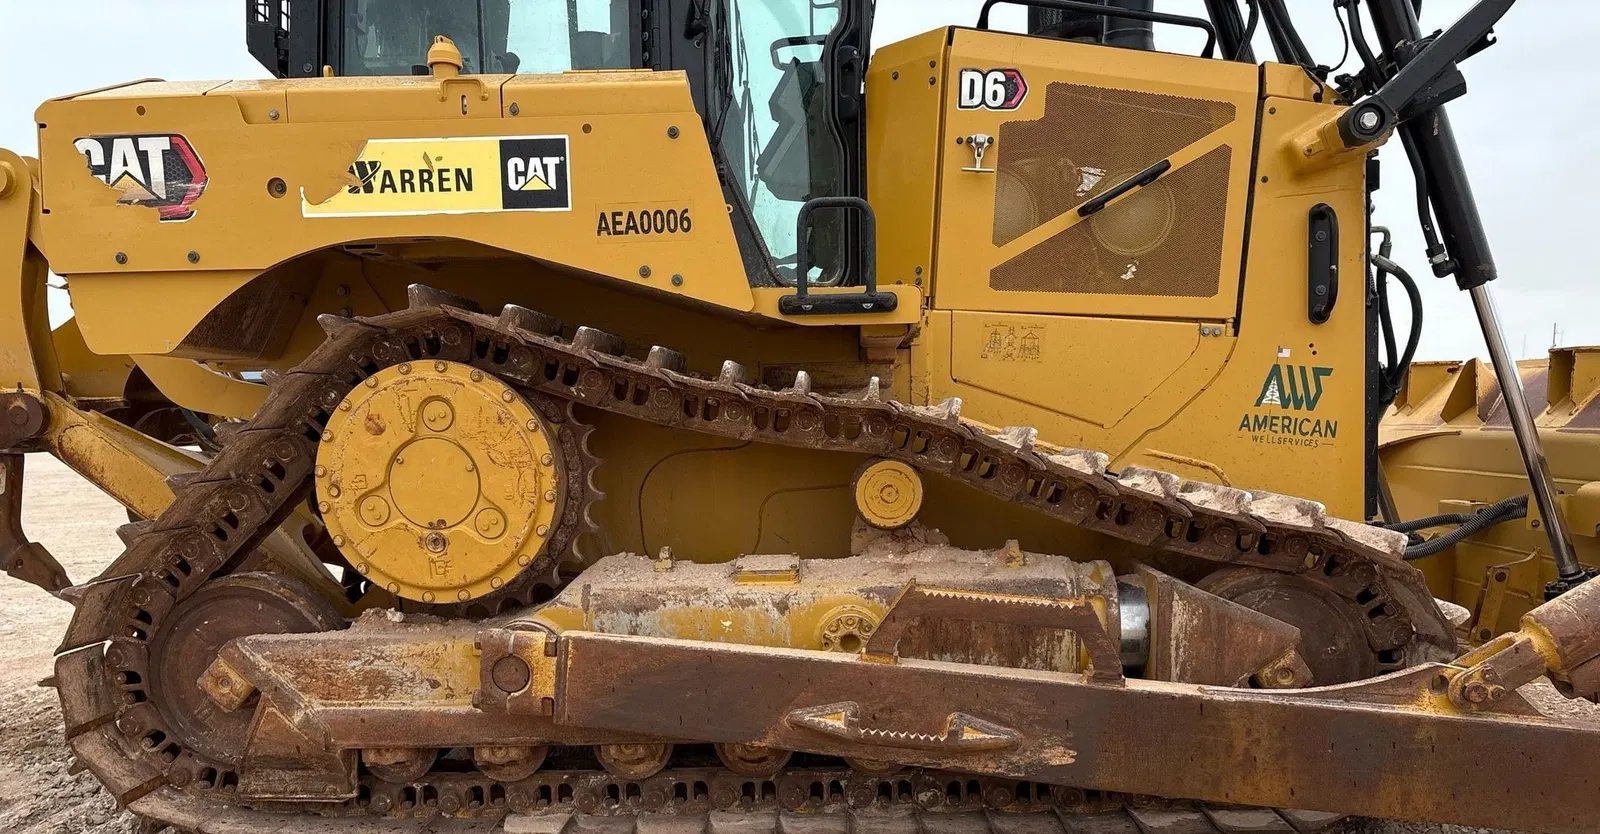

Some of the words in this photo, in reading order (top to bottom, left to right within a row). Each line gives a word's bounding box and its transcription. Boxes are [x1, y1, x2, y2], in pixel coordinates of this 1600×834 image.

[961, 70, 1006, 107] D6
[347, 160, 474, 195] WARREN
[507, 156, 560, 191] CAT
[597, 208, 692, 236] AEA0006
[1239, 413, 1338, 438] AMERICAN
